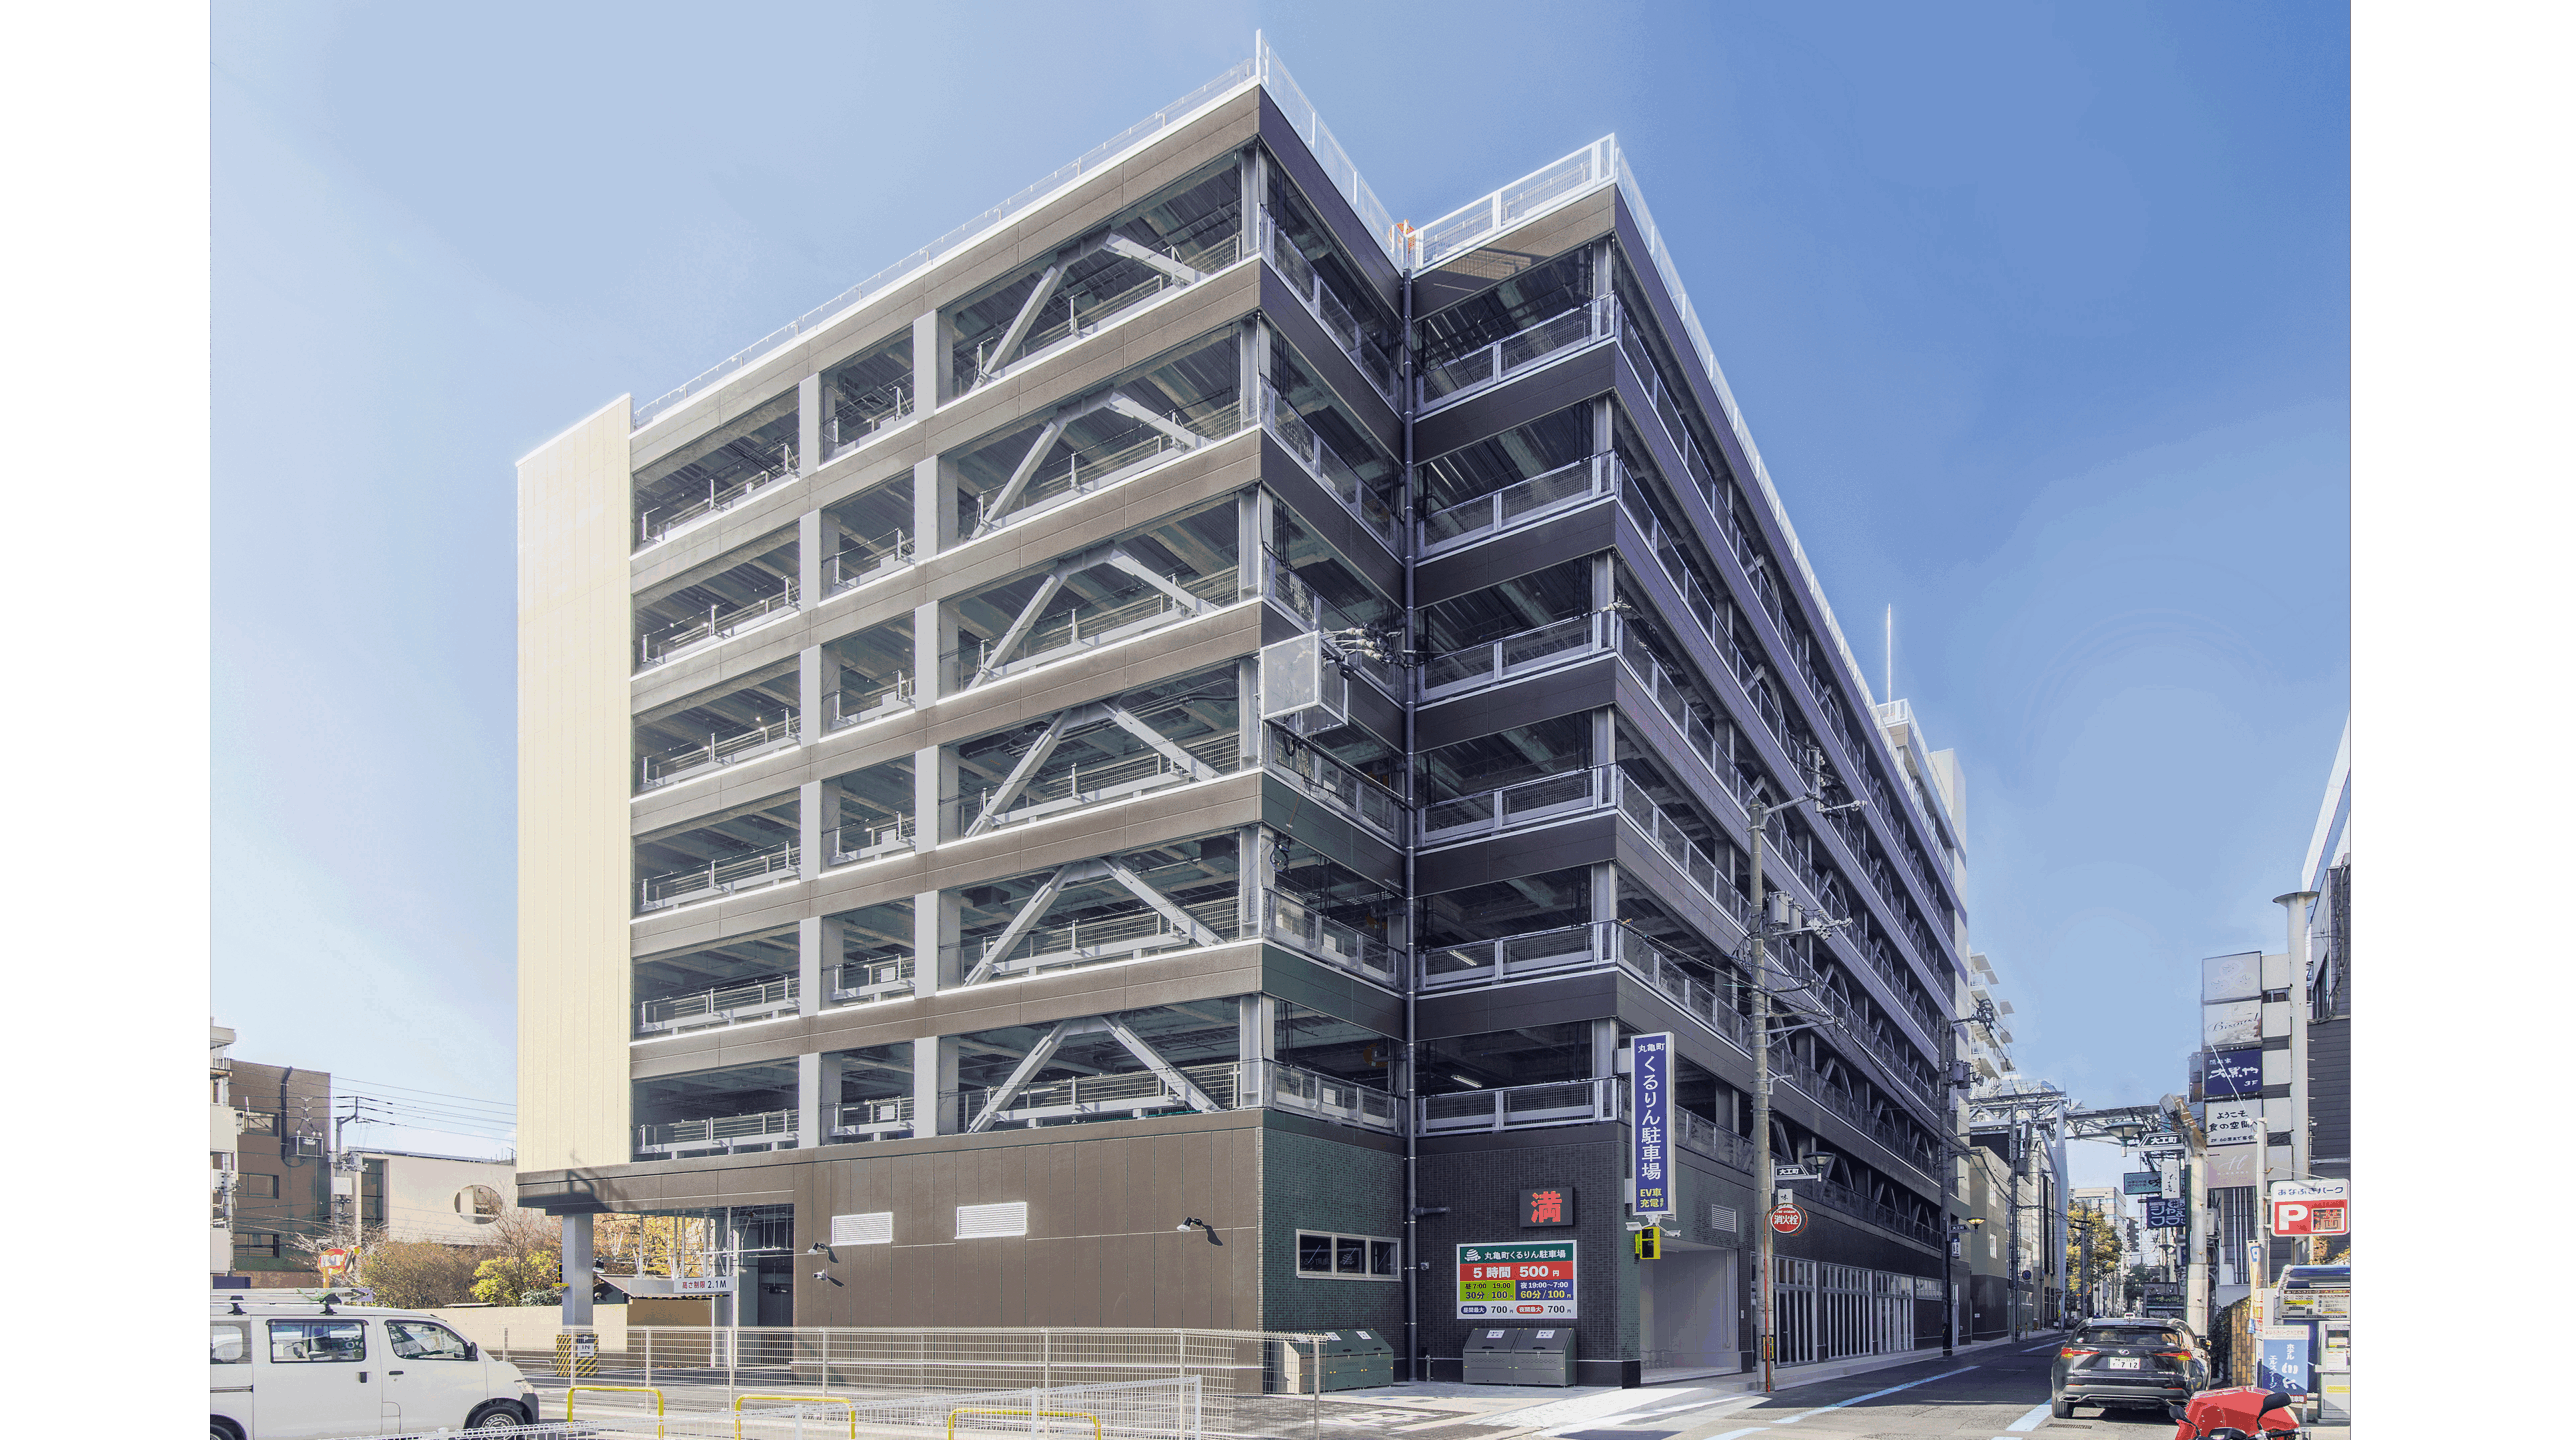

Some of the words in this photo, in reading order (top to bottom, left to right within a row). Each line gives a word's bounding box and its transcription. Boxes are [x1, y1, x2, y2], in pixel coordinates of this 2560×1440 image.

[1637, 1042, 1665, 1053] 丸亀町
[1642, 1056, 1662, 1180] くるりん駐車場
[2216, 1109, 2249, 1119] ようこそ
[2150, 1136, 2178, 1145] 大工町
[1640, 1187, 1662, 1197] EV車
[1531, 1190, 1563, 1223] 満
[1773, 1214, 1799, 1225] 消火栓
[2278, 1203, 2308, 1231] P
[1484, 1249, 1566, 1260] 丸亀町くるりん駐車場
[1473, 1266, 1482, 1279] 5
[1486, 1266, 1511, 1279] 時間
[1519, 1265, 1549, 1278] 500
[1552, 1269, 1560, 1277] 円
[682, 1280, 706, 1289] 高さ制限
[707, 1280, 727, 1289] 2.1M
[1491, 1306, 1508, 1314] 700
[1547, 1305, 1565, 1313] 700
[2286, 1343, 2295, 1360] ホテル
